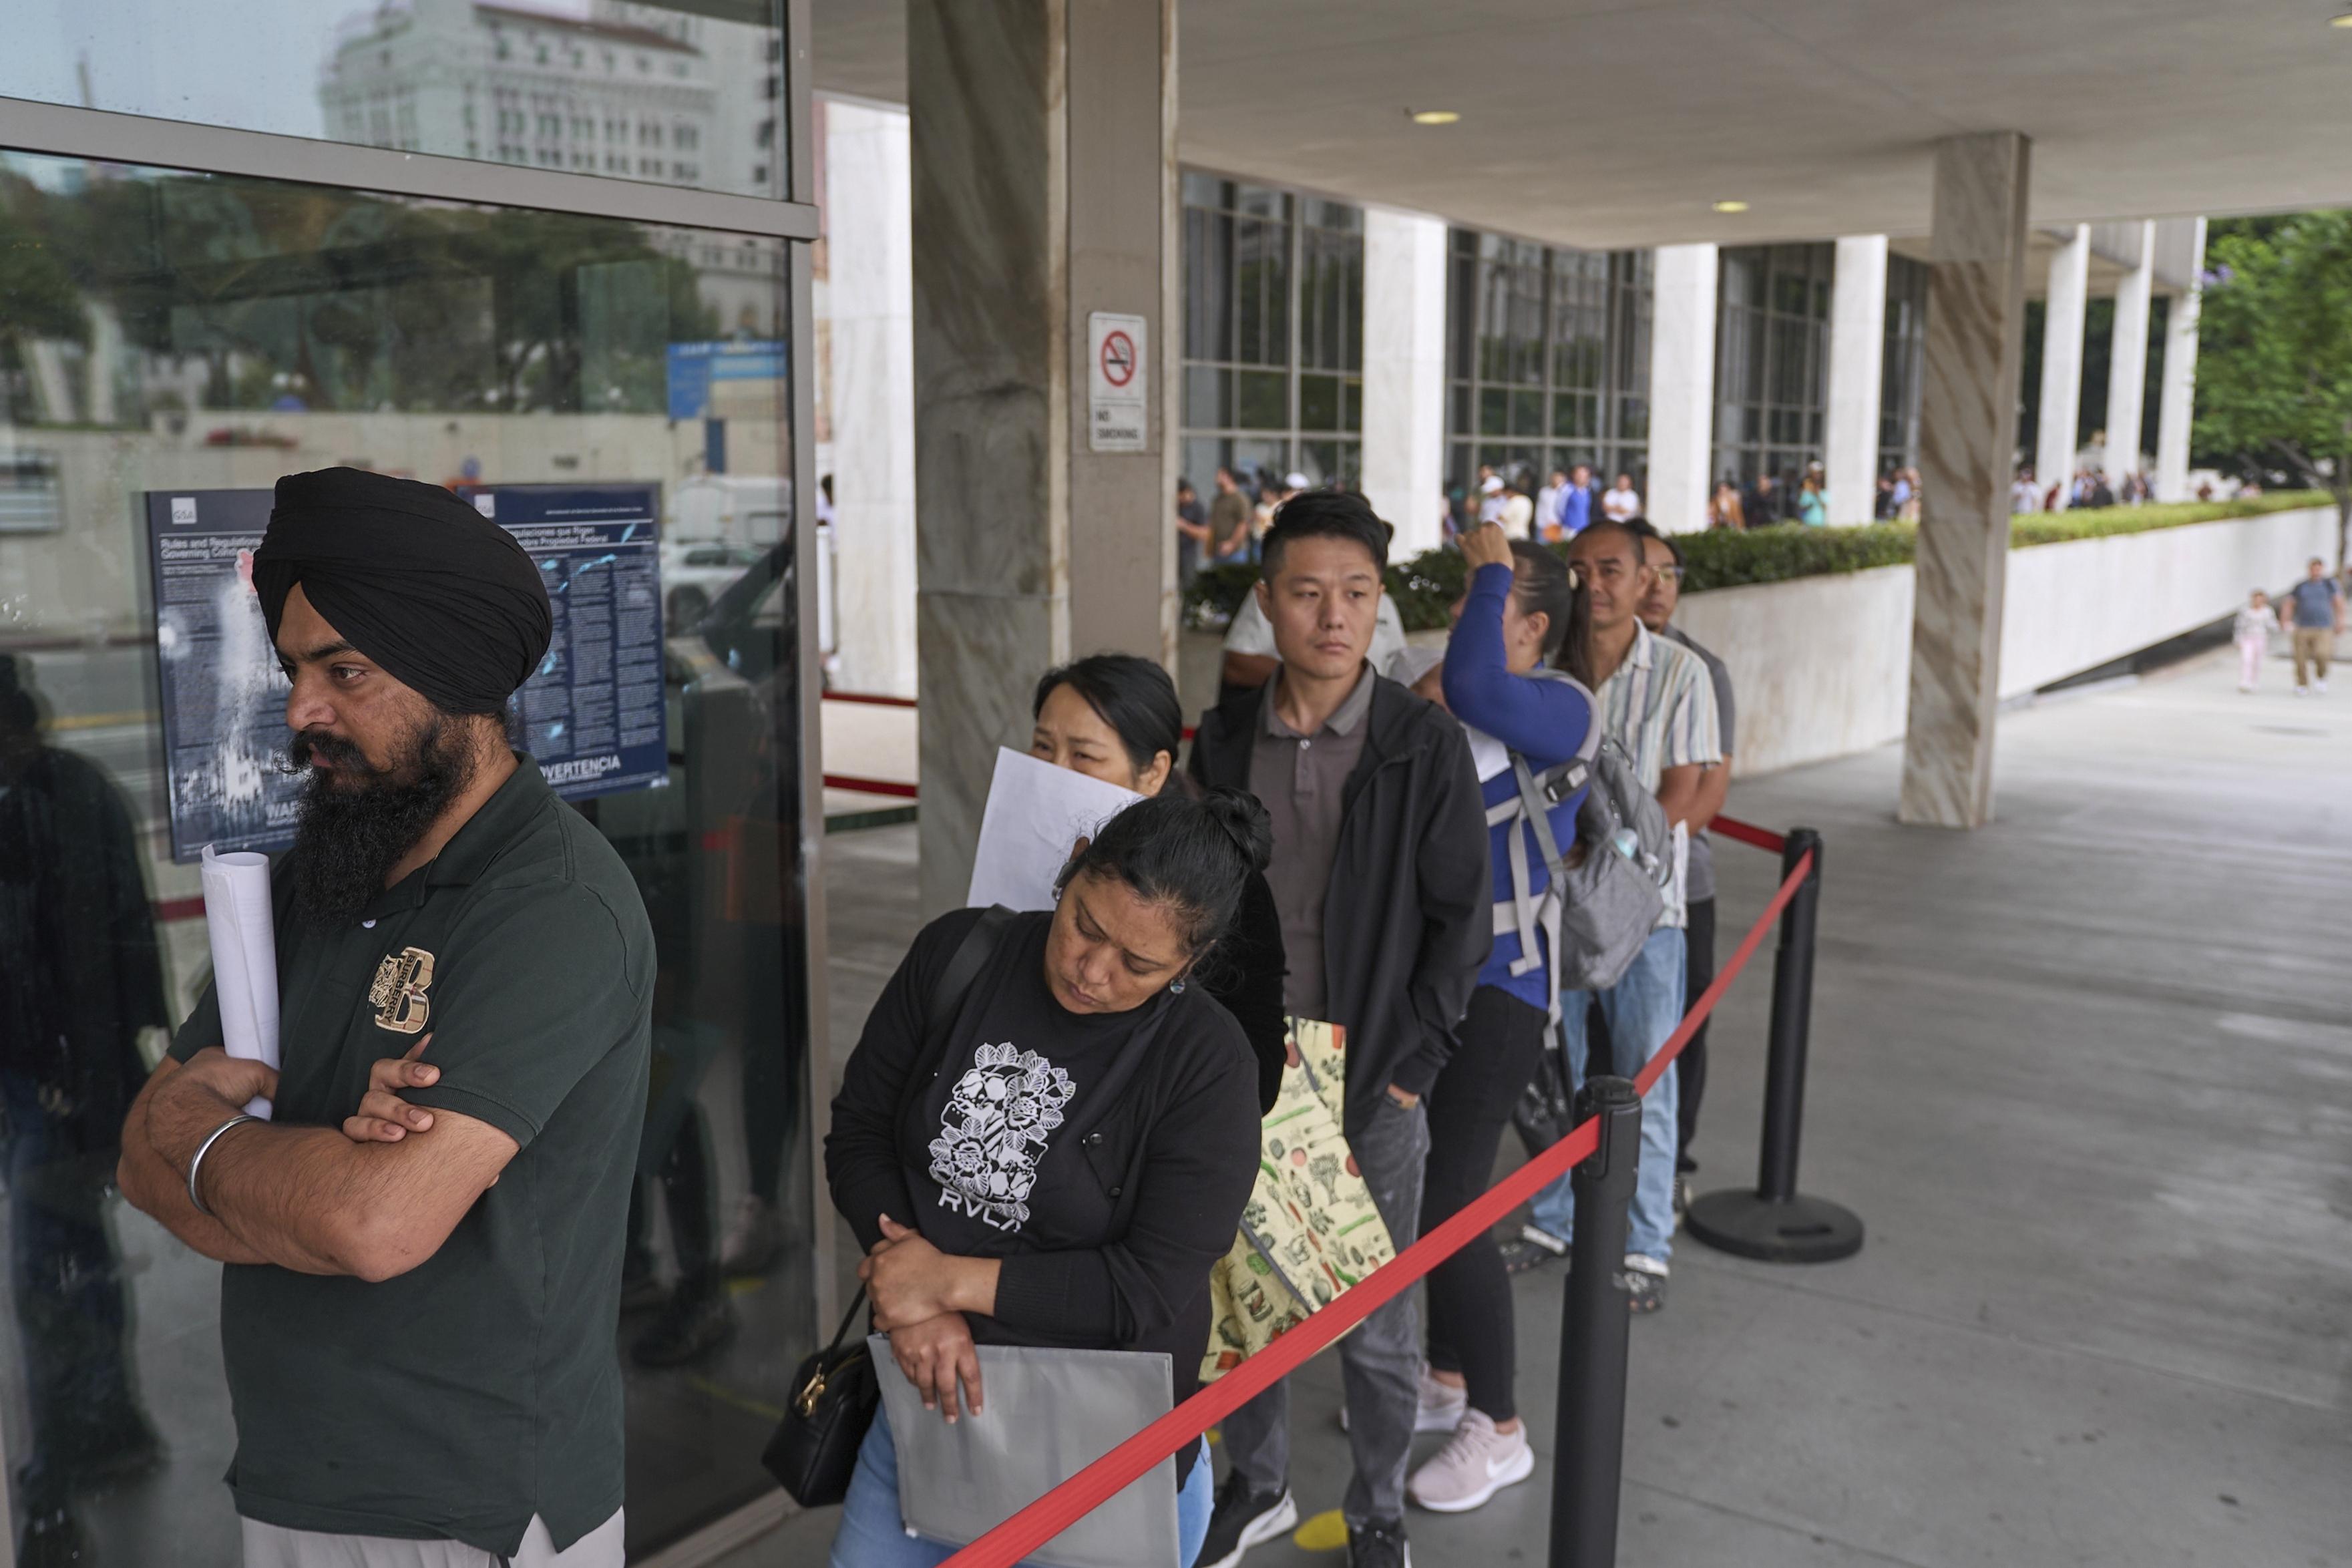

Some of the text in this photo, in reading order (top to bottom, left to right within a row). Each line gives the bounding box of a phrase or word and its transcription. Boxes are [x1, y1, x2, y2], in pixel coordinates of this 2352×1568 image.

[509, 528, 555, 540] egulaciones
[161, 538, 188, 549] Rules
[190, 538, 208, 548] and
[161, 547, 238, 560] Governing Cond
[540, 754, 621, 778] VERTENCIA
[384, 955, 415, 1024] BURBERRY
